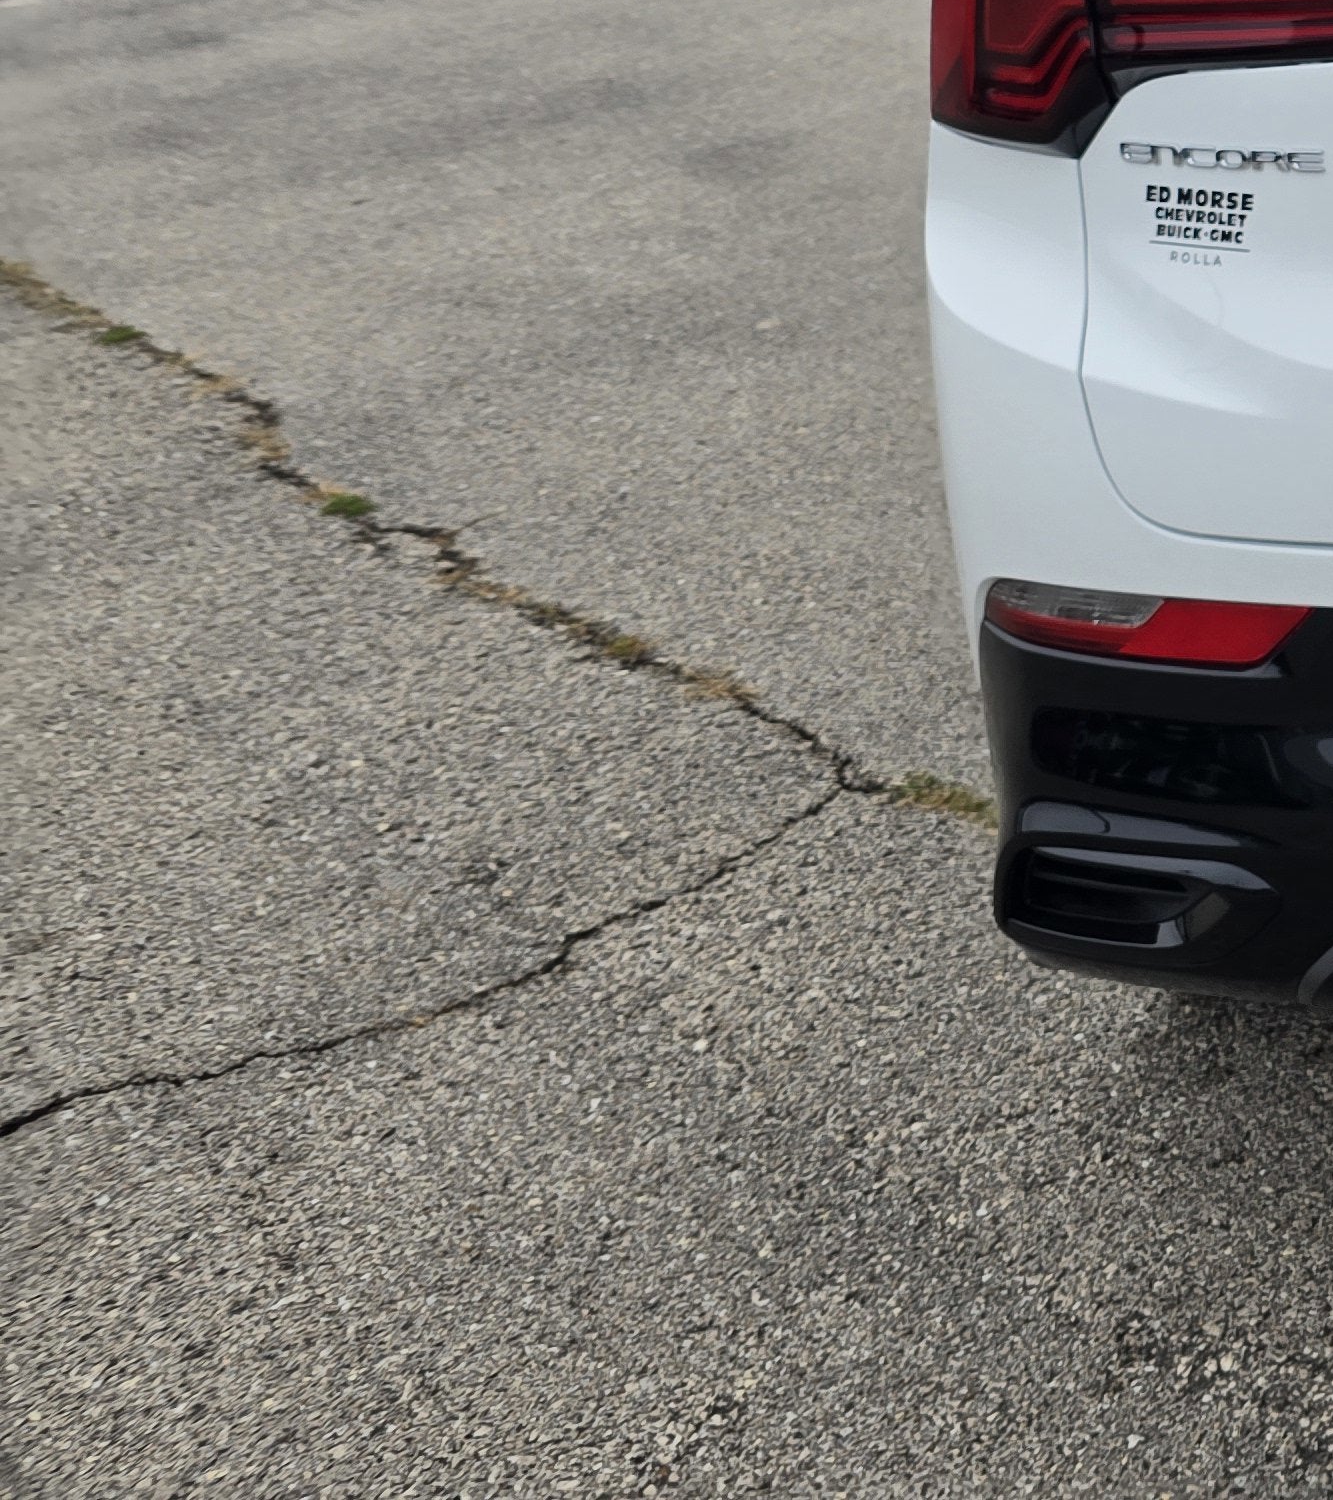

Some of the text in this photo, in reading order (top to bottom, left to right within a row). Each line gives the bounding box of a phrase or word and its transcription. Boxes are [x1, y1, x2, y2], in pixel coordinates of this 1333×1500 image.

[1119, 141, 1327, 174] ENCORE
[1146, 185, 1254, 211] ED MORSE
[1155, 206, 1247, 228] CHEVROLET
[1170, 250, 1222, 267] ROLLA
